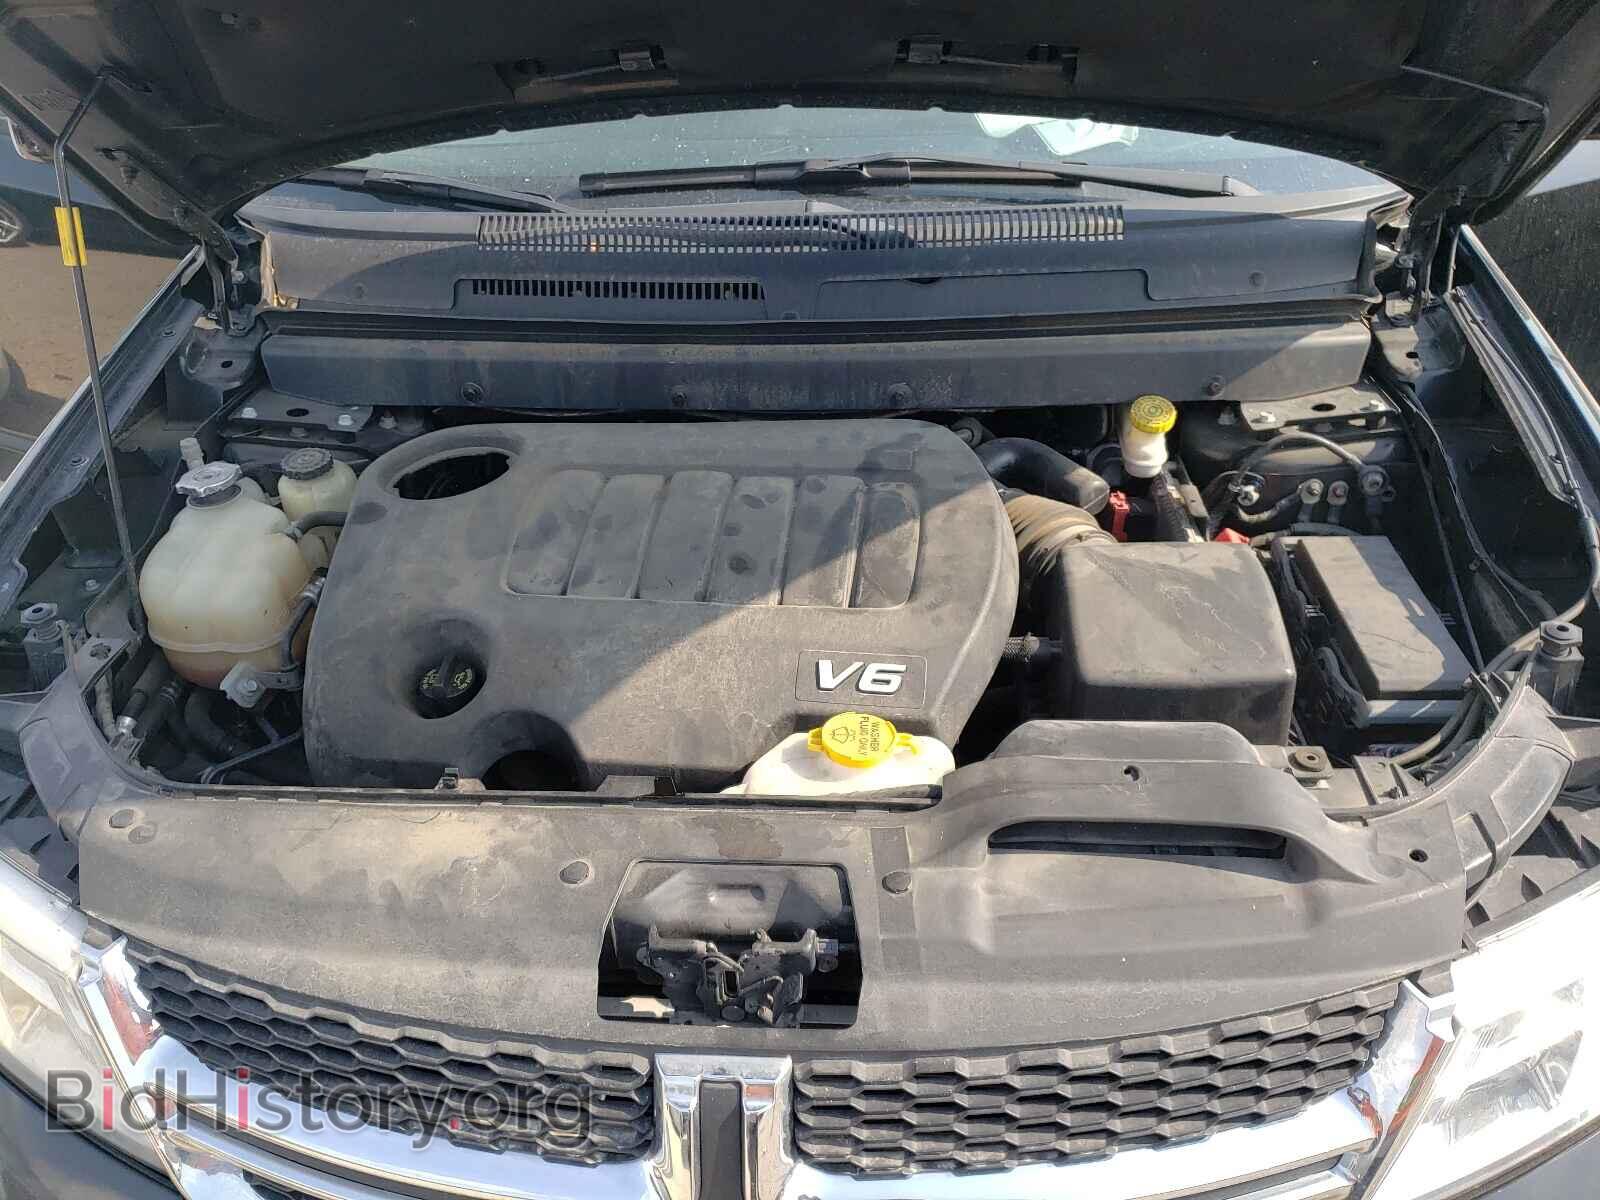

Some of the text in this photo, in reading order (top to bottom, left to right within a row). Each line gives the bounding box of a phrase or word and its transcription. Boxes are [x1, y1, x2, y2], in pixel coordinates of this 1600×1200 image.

[816, 659, 907, 694] V6
[858, 716, 869, 755] FLUID ONLY
[871, 721, 880, 751] WASHER
